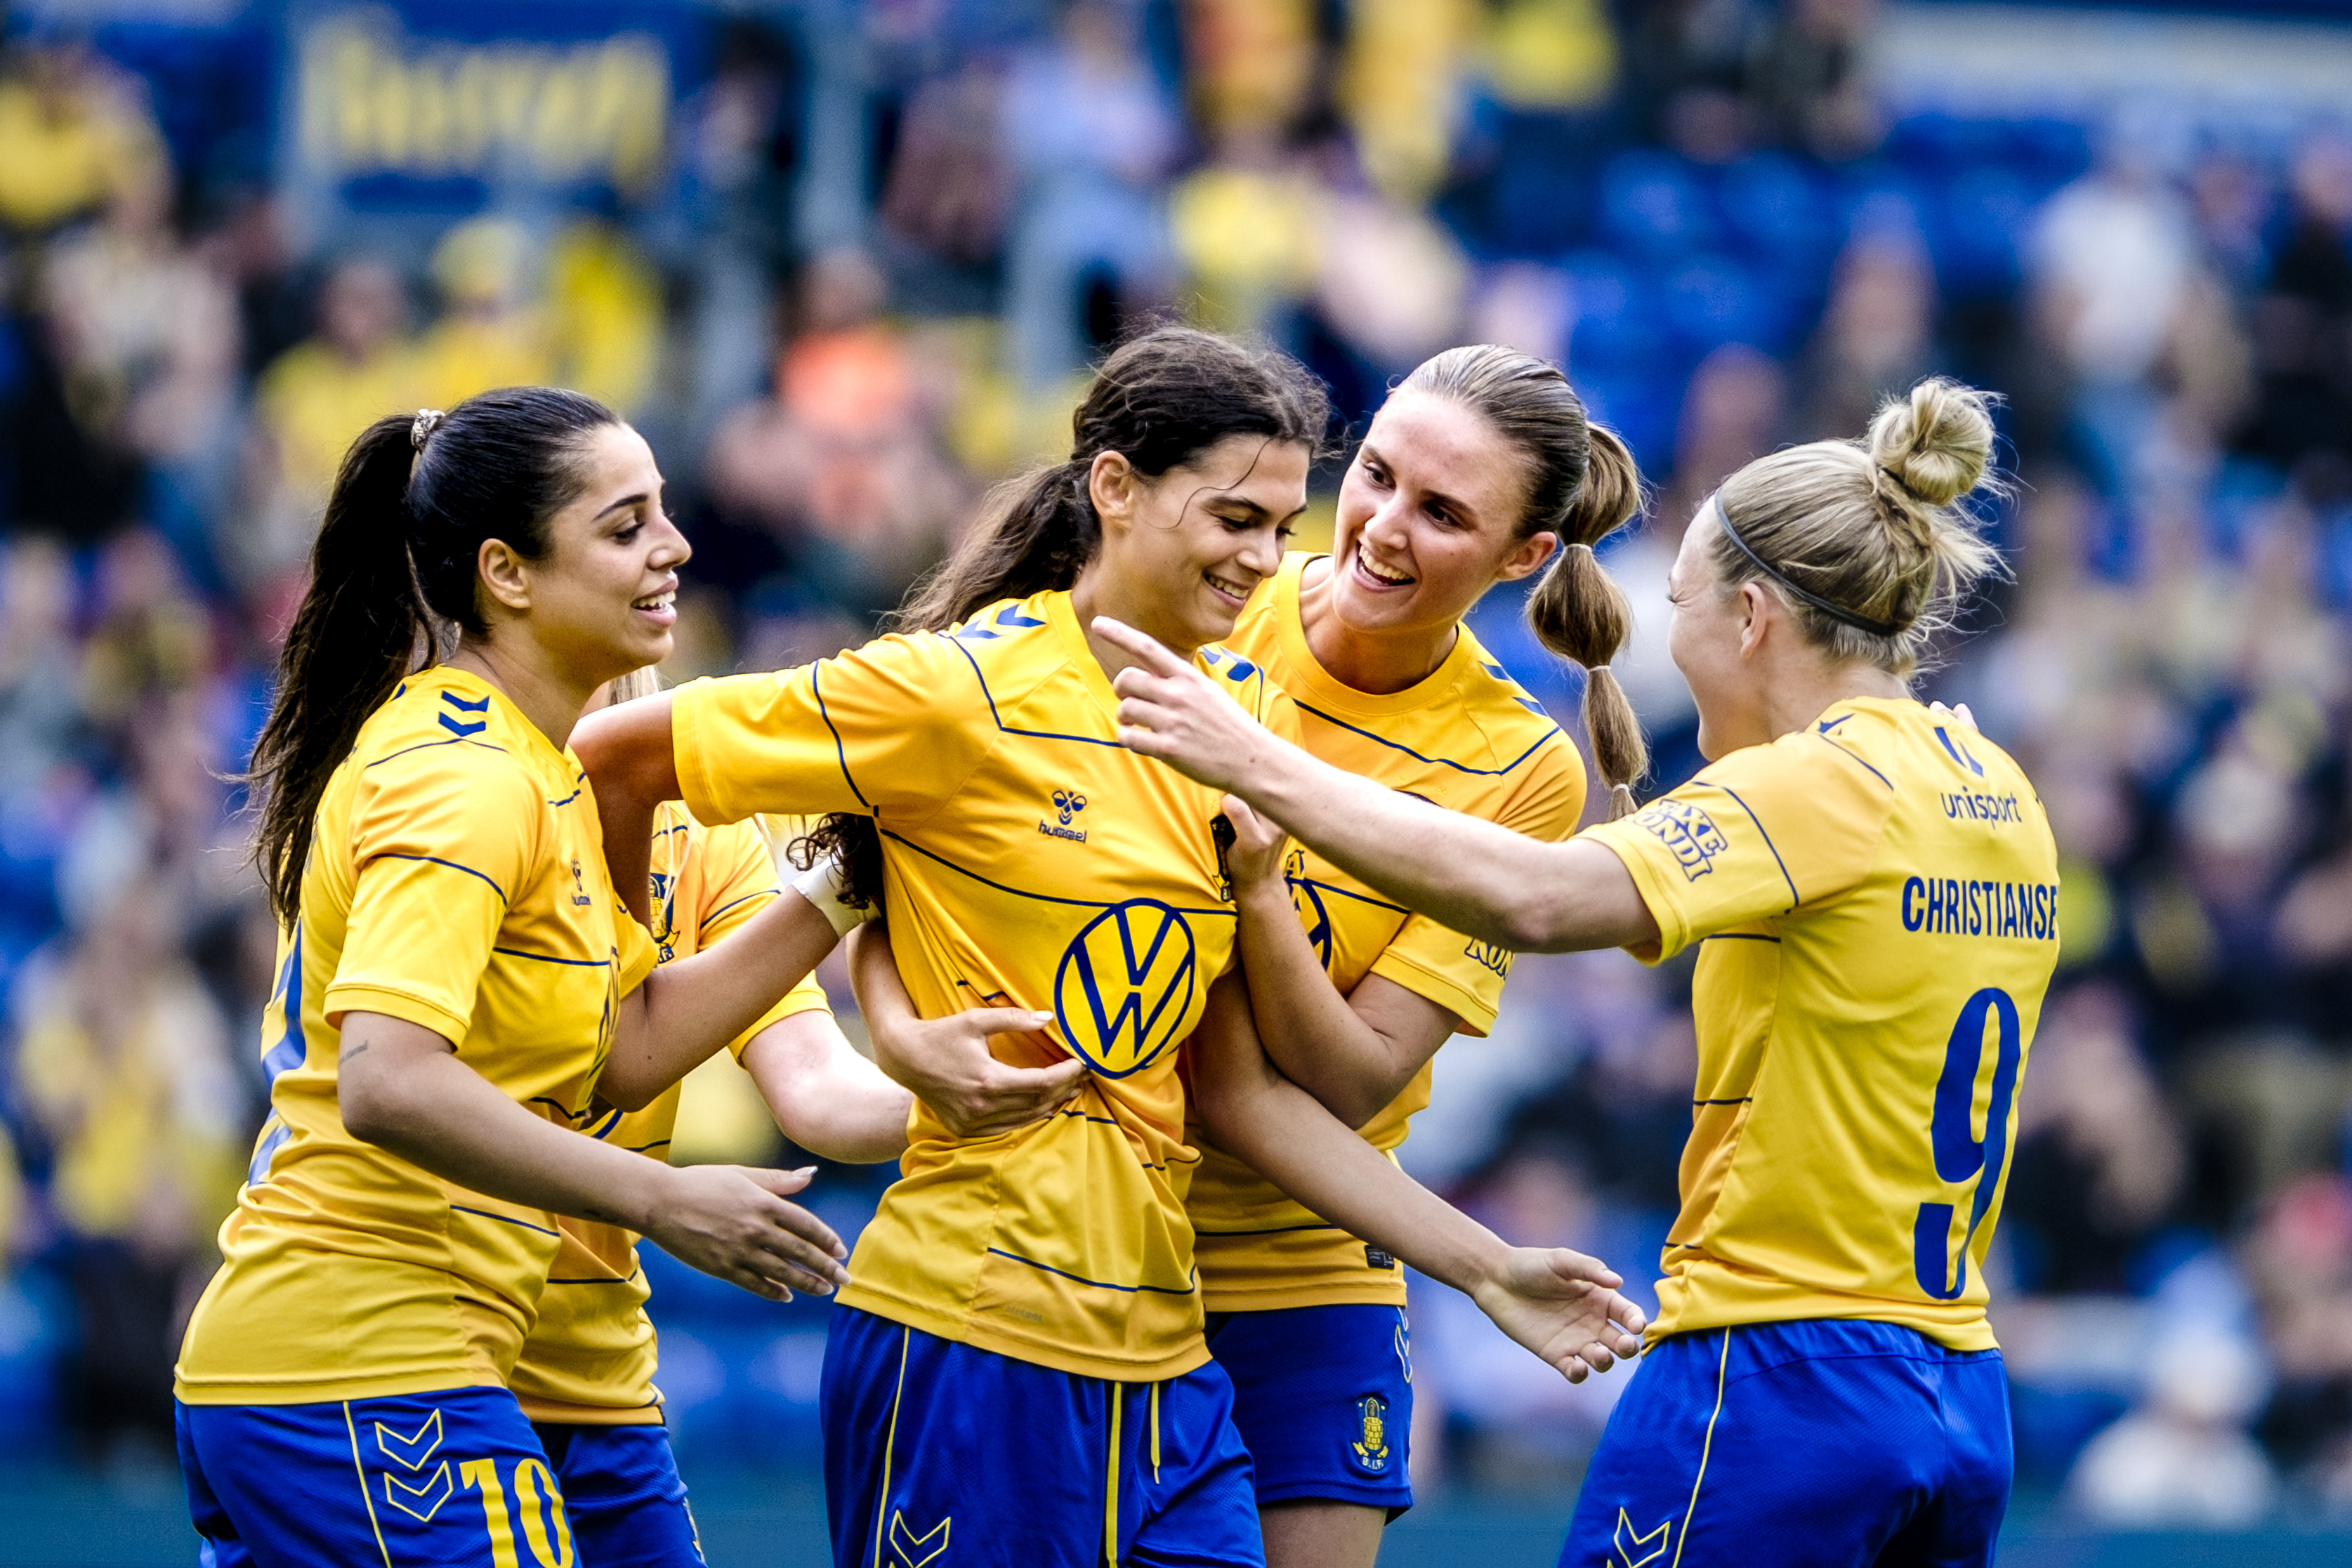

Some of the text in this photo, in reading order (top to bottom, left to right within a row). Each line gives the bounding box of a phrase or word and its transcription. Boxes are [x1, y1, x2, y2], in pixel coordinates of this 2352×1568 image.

[1038, 819, 1087, 843] hummel
[1940, 785, 2023, 830] unisport
[1913, 987, 2021, 1300] 9
[459, 1458, 574, 1568] 10
